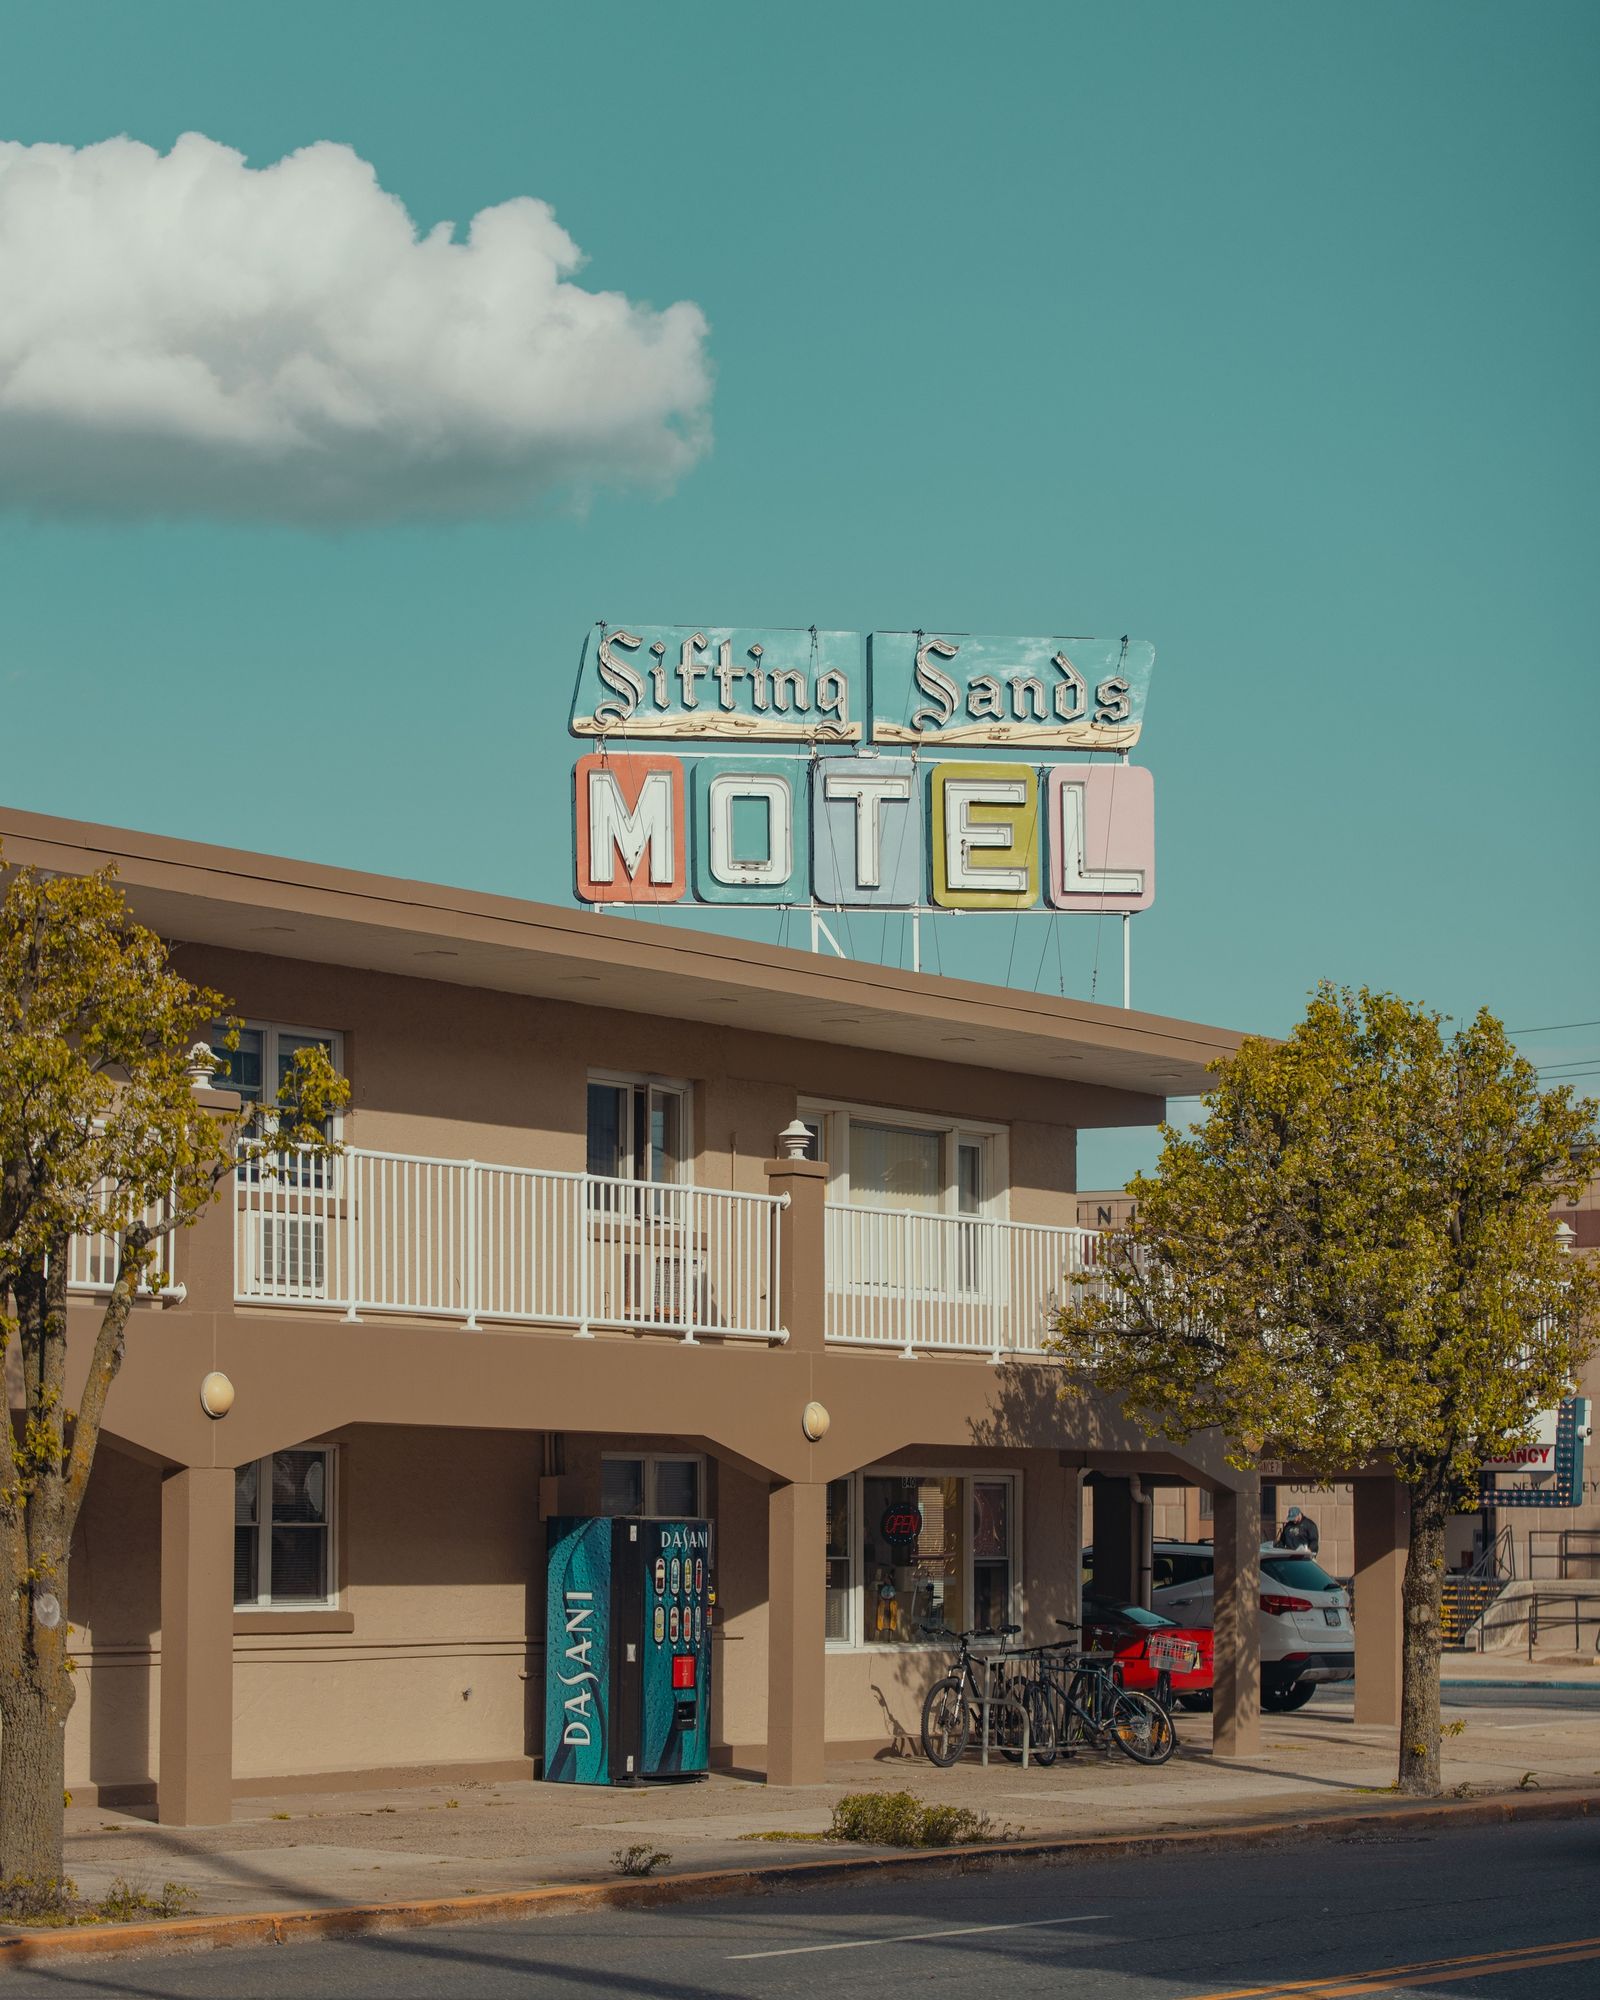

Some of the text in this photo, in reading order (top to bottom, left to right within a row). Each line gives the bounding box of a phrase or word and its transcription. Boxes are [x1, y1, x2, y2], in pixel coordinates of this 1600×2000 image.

[593, 629, 1132, 736] Sifting Sands
[589, 768, 1145, 895] MOTEL
[1290, 1484, 1335, 1494] OCEAN
[1512, 1481, 1542, 1490] NEW
[886, 1514, 919, 1535] OPEN
[661, 1526, 708, 1552] DASANI
[557, 1591, 599, 1746] DASANI
